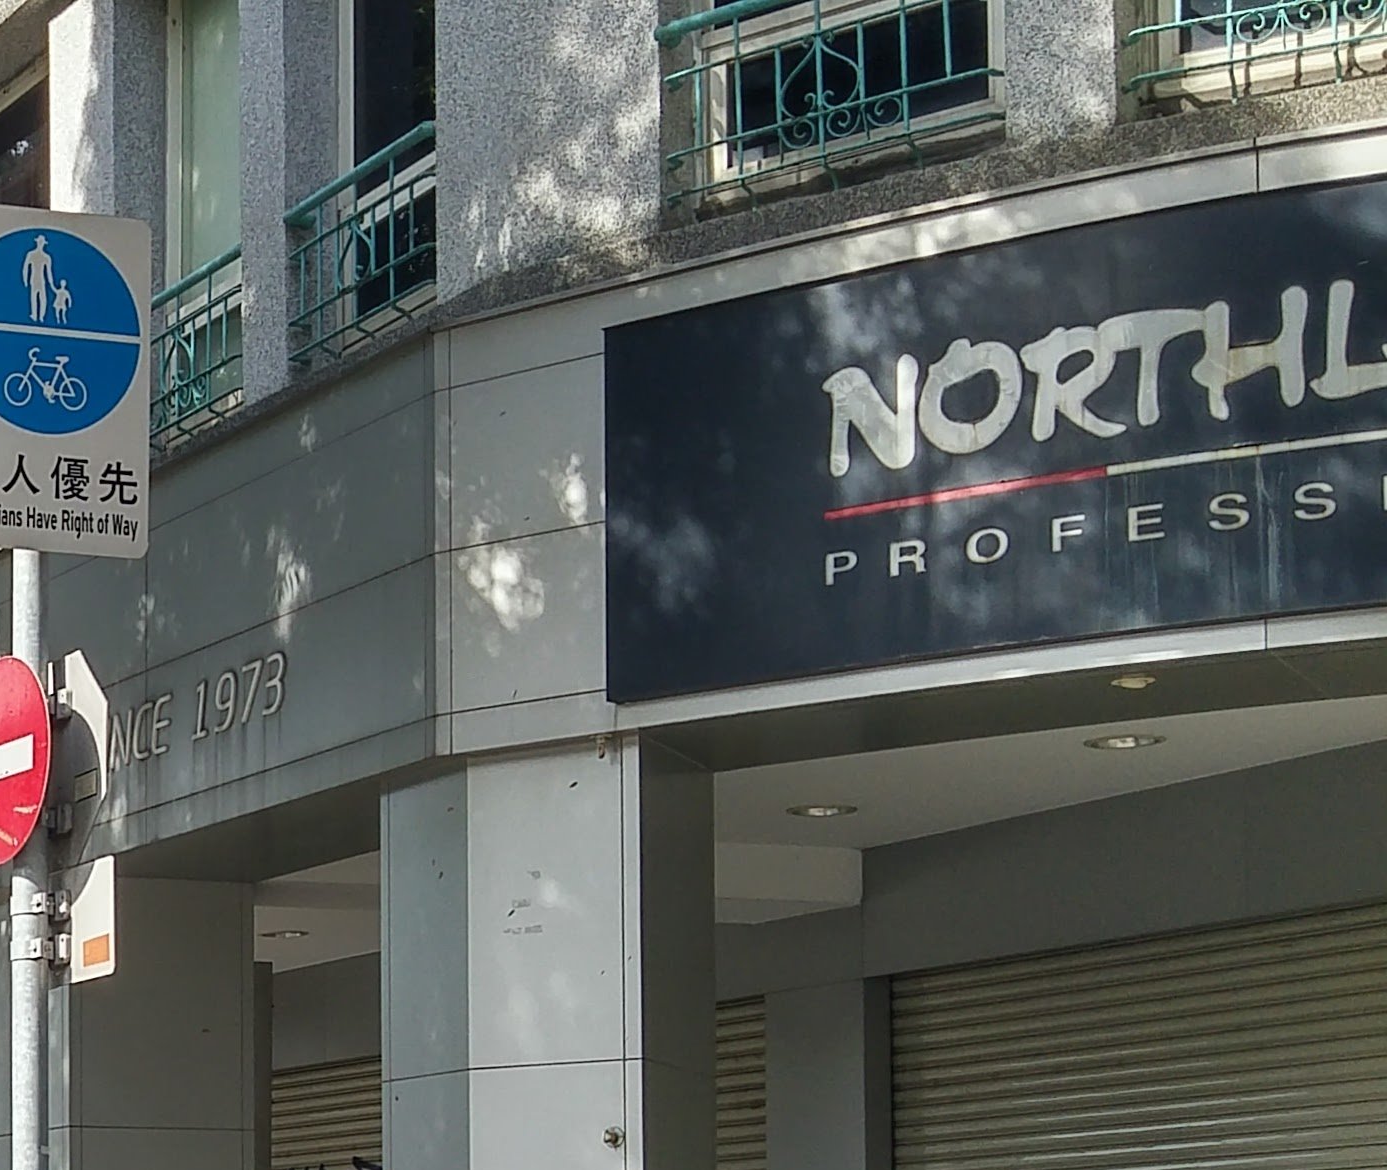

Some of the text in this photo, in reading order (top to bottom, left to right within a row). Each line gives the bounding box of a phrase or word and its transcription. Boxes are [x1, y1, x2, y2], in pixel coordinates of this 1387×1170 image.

[822, 279, 1387, 477] NORTHL
[26, 505, 58, 531] Have
[61, 509, 94, 539] Right
[97, 513, 109, 535] of
[112, 514, 138, 542] Way
[109, 652, 287, 773] NCE 1973
